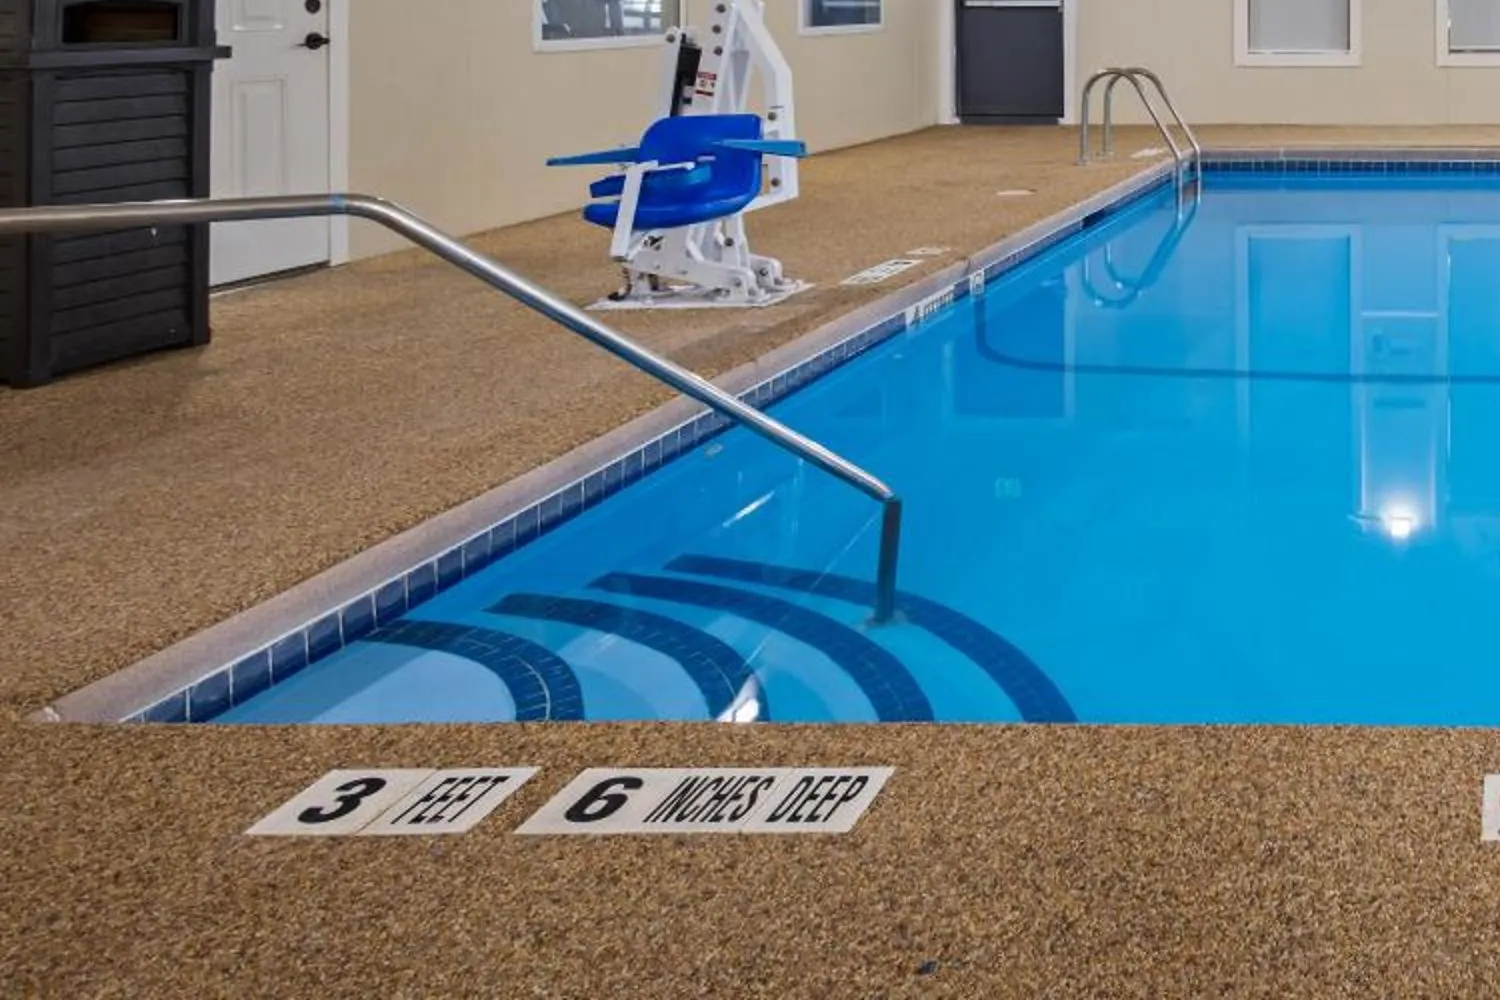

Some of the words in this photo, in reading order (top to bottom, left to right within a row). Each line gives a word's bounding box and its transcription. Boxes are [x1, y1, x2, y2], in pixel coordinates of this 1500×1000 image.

[297, 777, 387, 824] 3
[390, 775, 511, 825] FEET
[564, 776, 644, 823] 6
[642, 775, 775, 823] INCHES
[764, 775, 869, 823] DEEP
